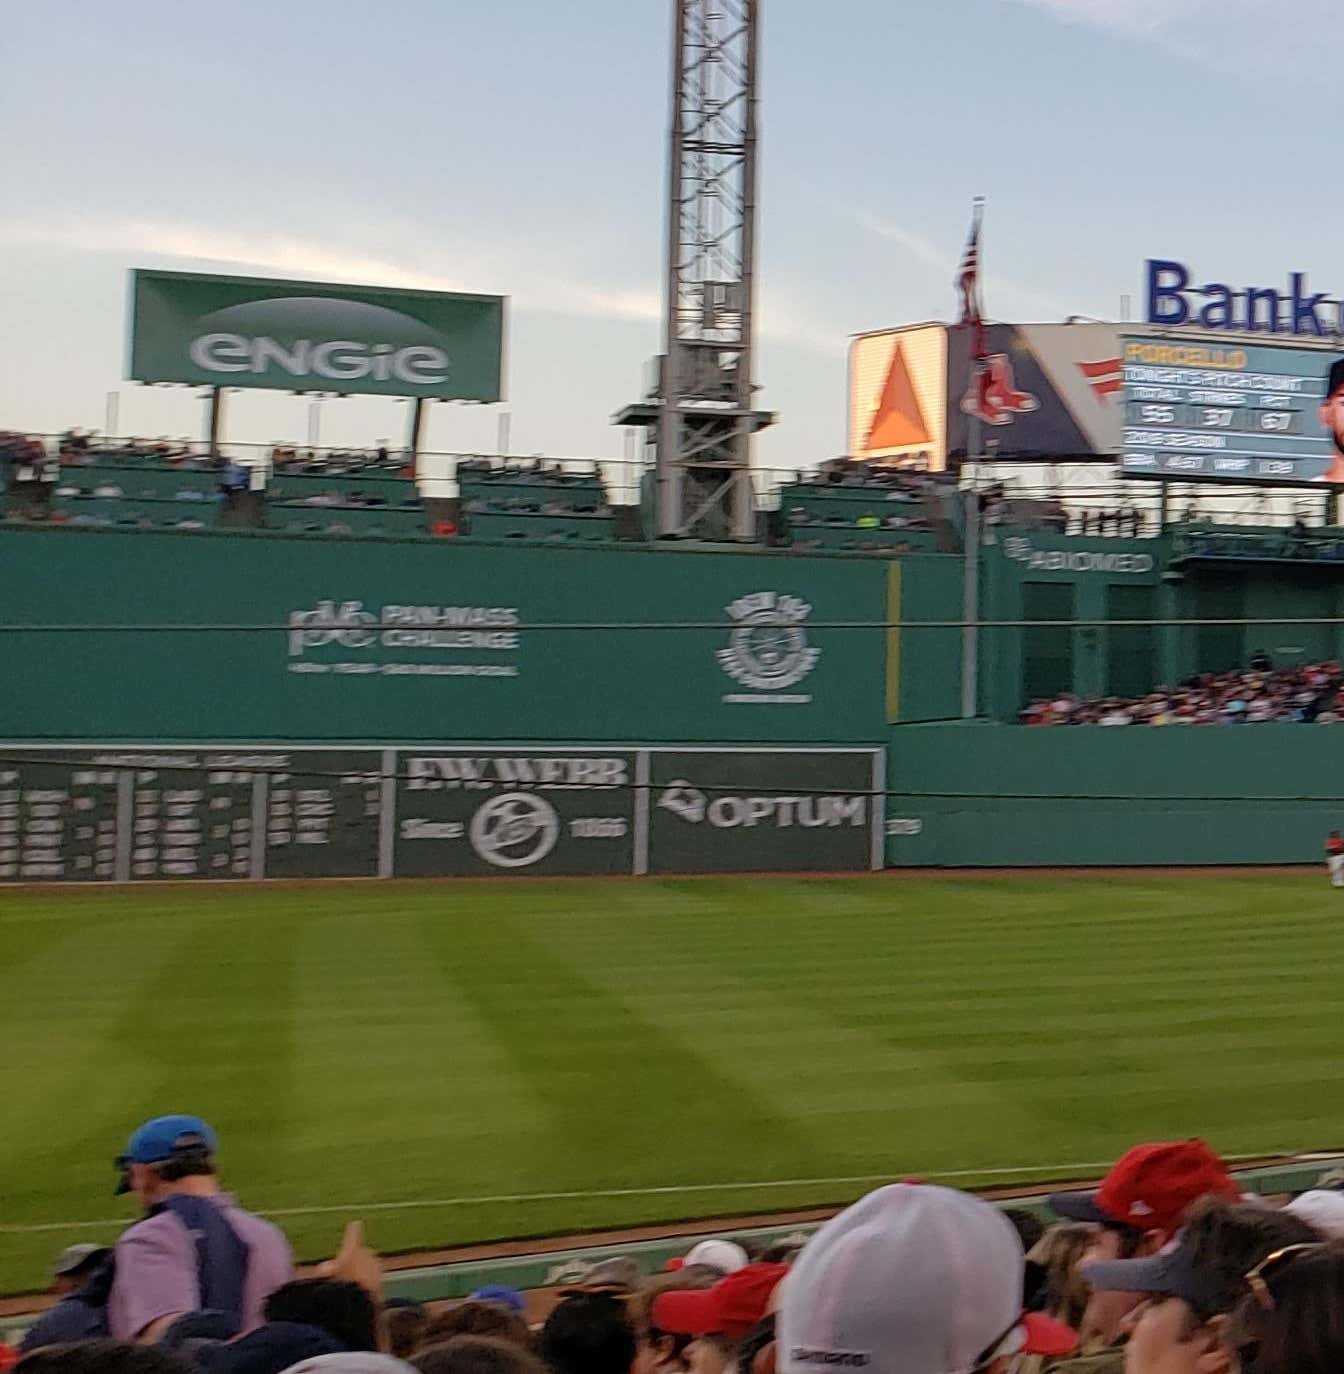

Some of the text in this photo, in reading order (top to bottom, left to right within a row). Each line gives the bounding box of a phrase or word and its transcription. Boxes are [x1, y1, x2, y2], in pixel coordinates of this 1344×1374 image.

[1143, 258, 1341, 334] Bank
[1127, 343, 1248, 369] PORCELLO
[1140, 404, 1176, 424] 55
[1202, 408, 1235, 427] 37
[1029, 550, 1154, 573] ABIOMED
[706, 794, 869, 829] OPTUM
